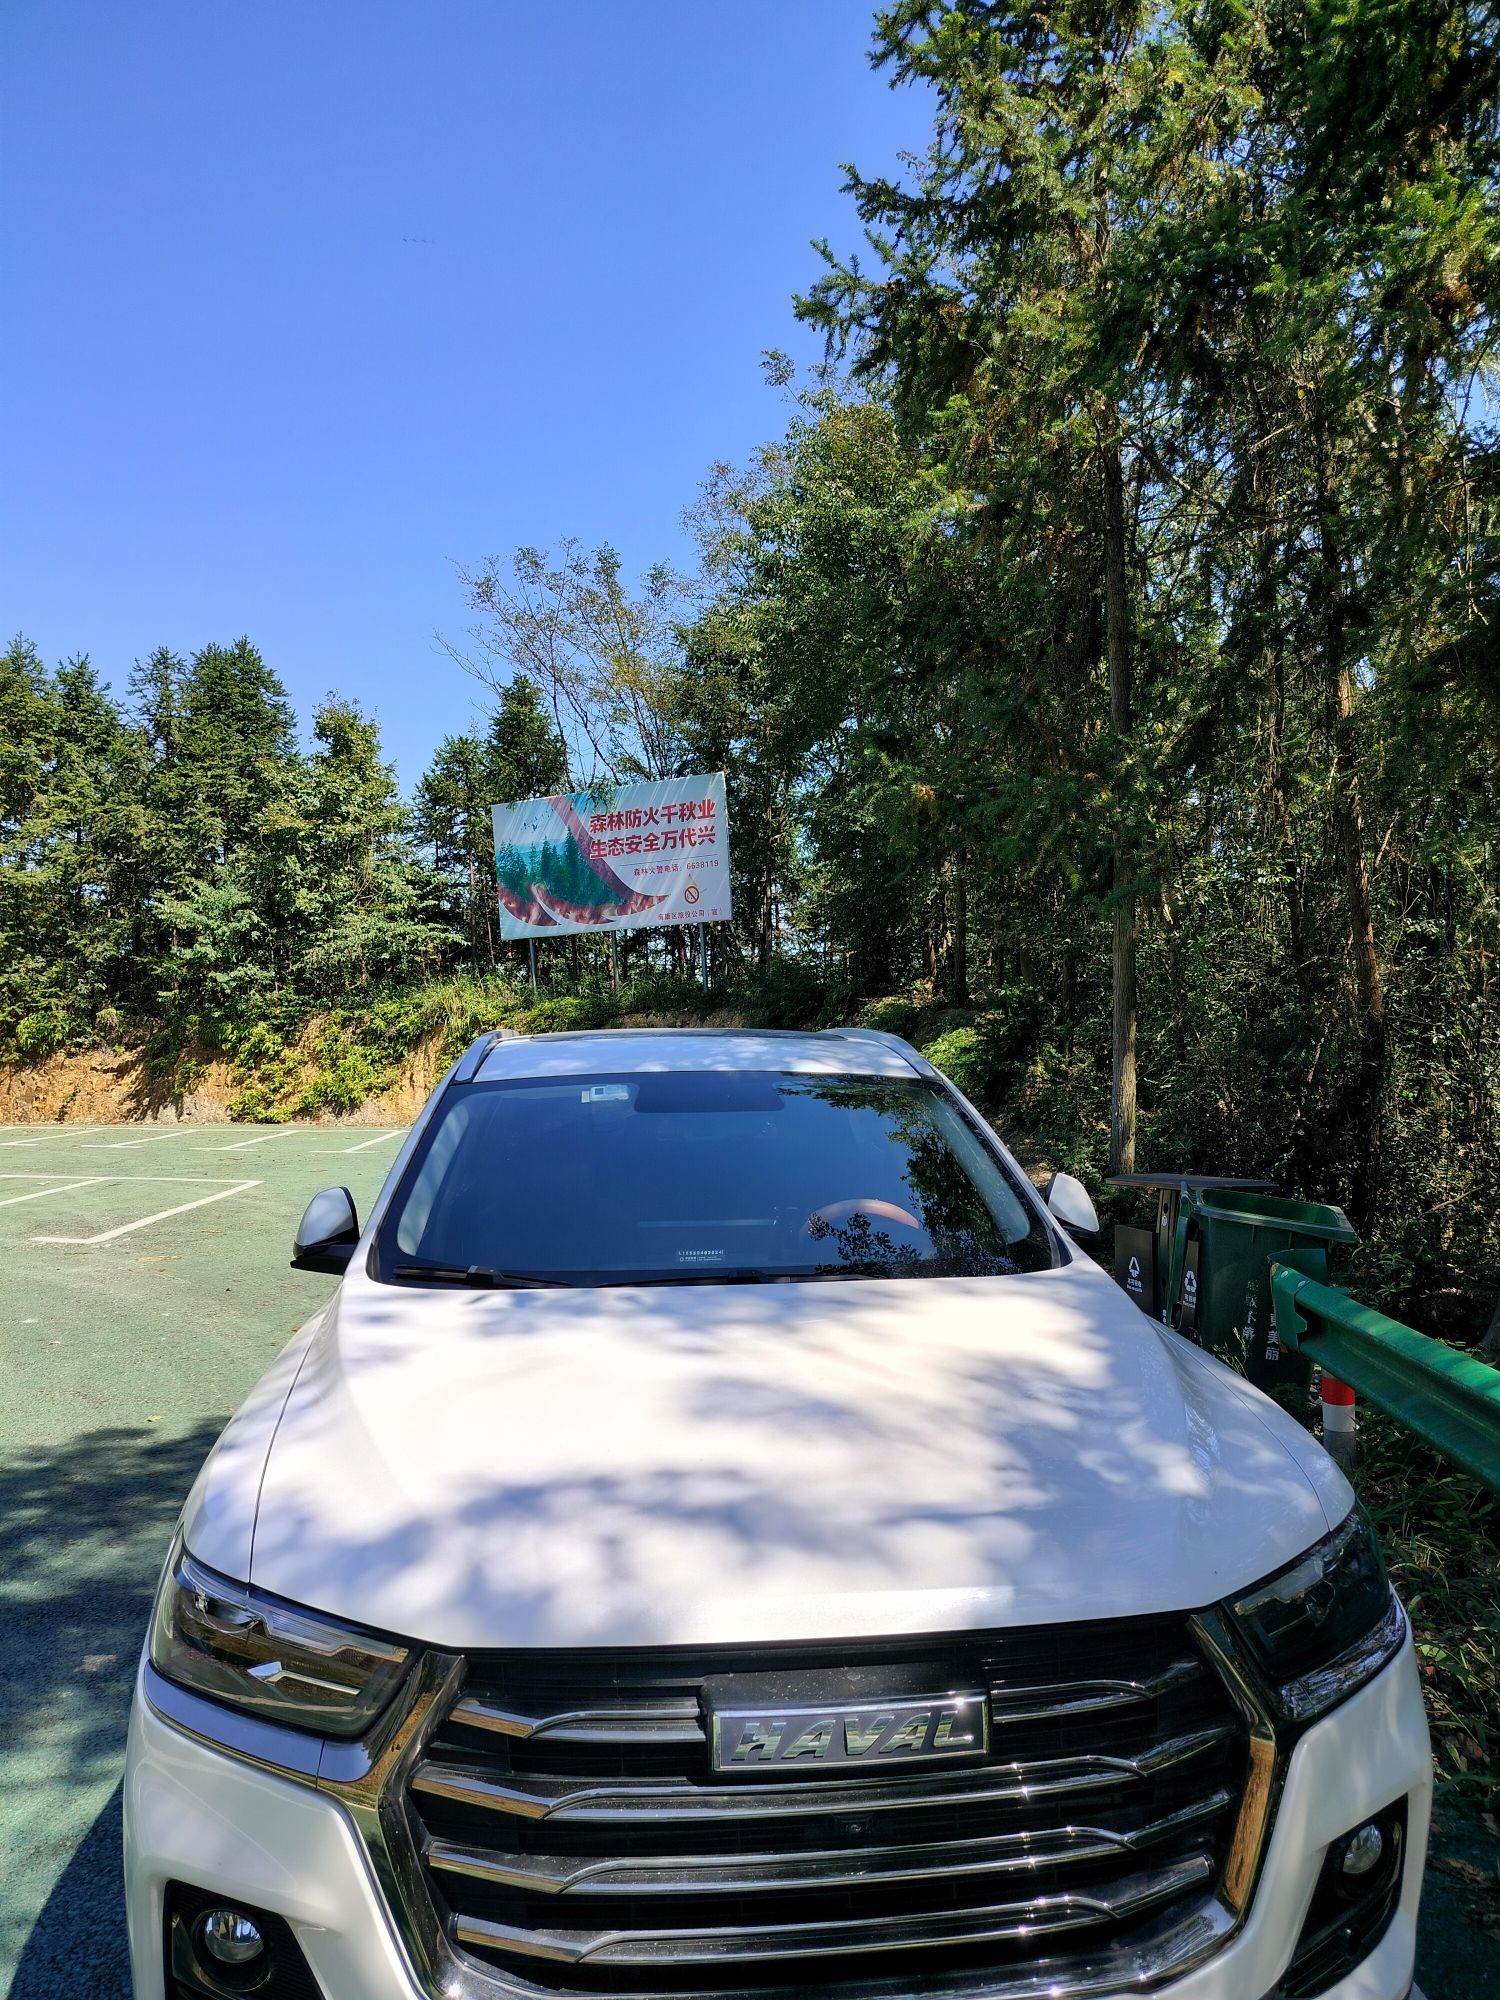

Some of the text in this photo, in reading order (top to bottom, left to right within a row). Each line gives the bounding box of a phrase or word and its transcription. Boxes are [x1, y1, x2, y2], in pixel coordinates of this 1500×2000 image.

[590, 799, 716, 834] 森林防火千秋业
[590, 825, 716, 860] 生态安全万代兴
[731, 1710, 974, 1761] HAVAL
